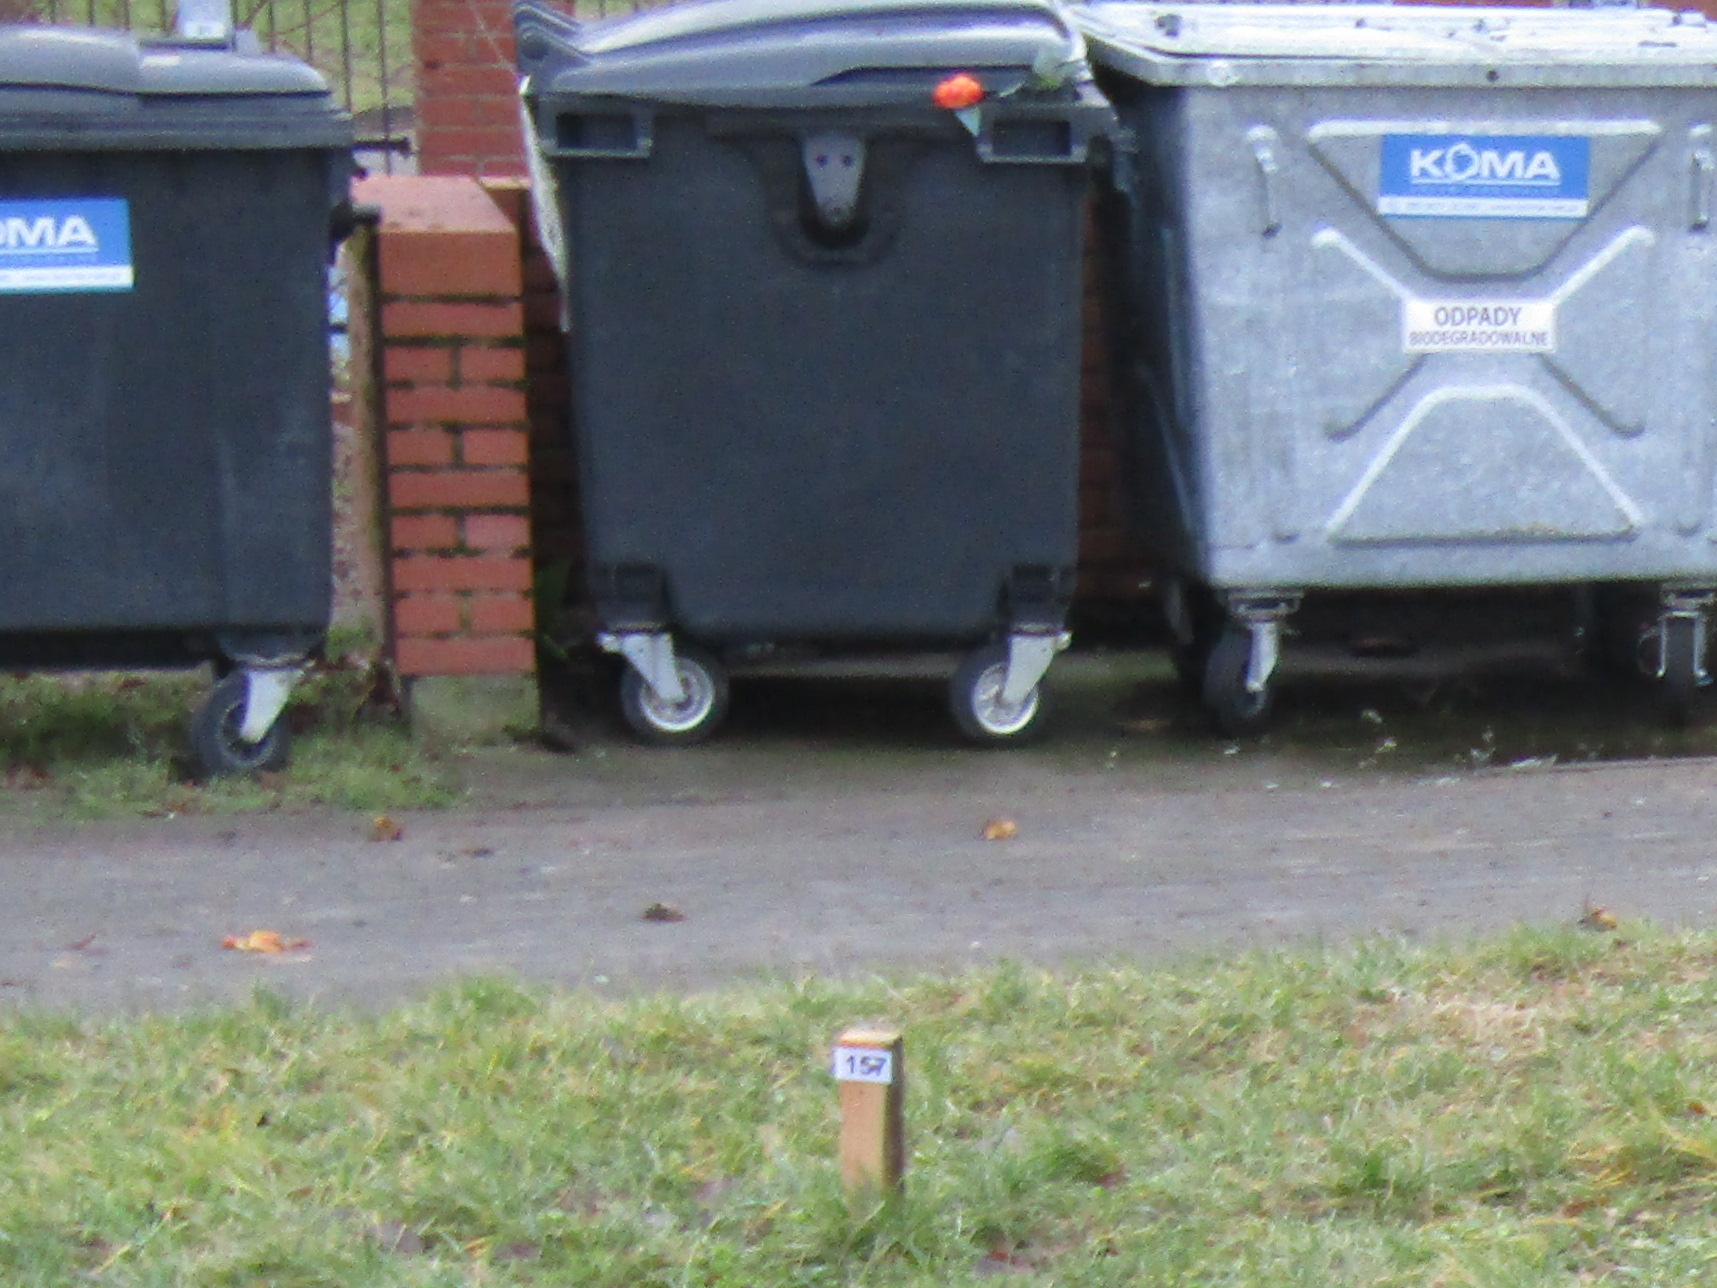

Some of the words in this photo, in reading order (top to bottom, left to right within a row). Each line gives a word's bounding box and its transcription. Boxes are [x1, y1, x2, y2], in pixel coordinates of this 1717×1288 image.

[1410, 143, 1562, 181] KOMA
[0, 215, 99, 246] MA
[1434, 306, 1523, 326] ODPADY
